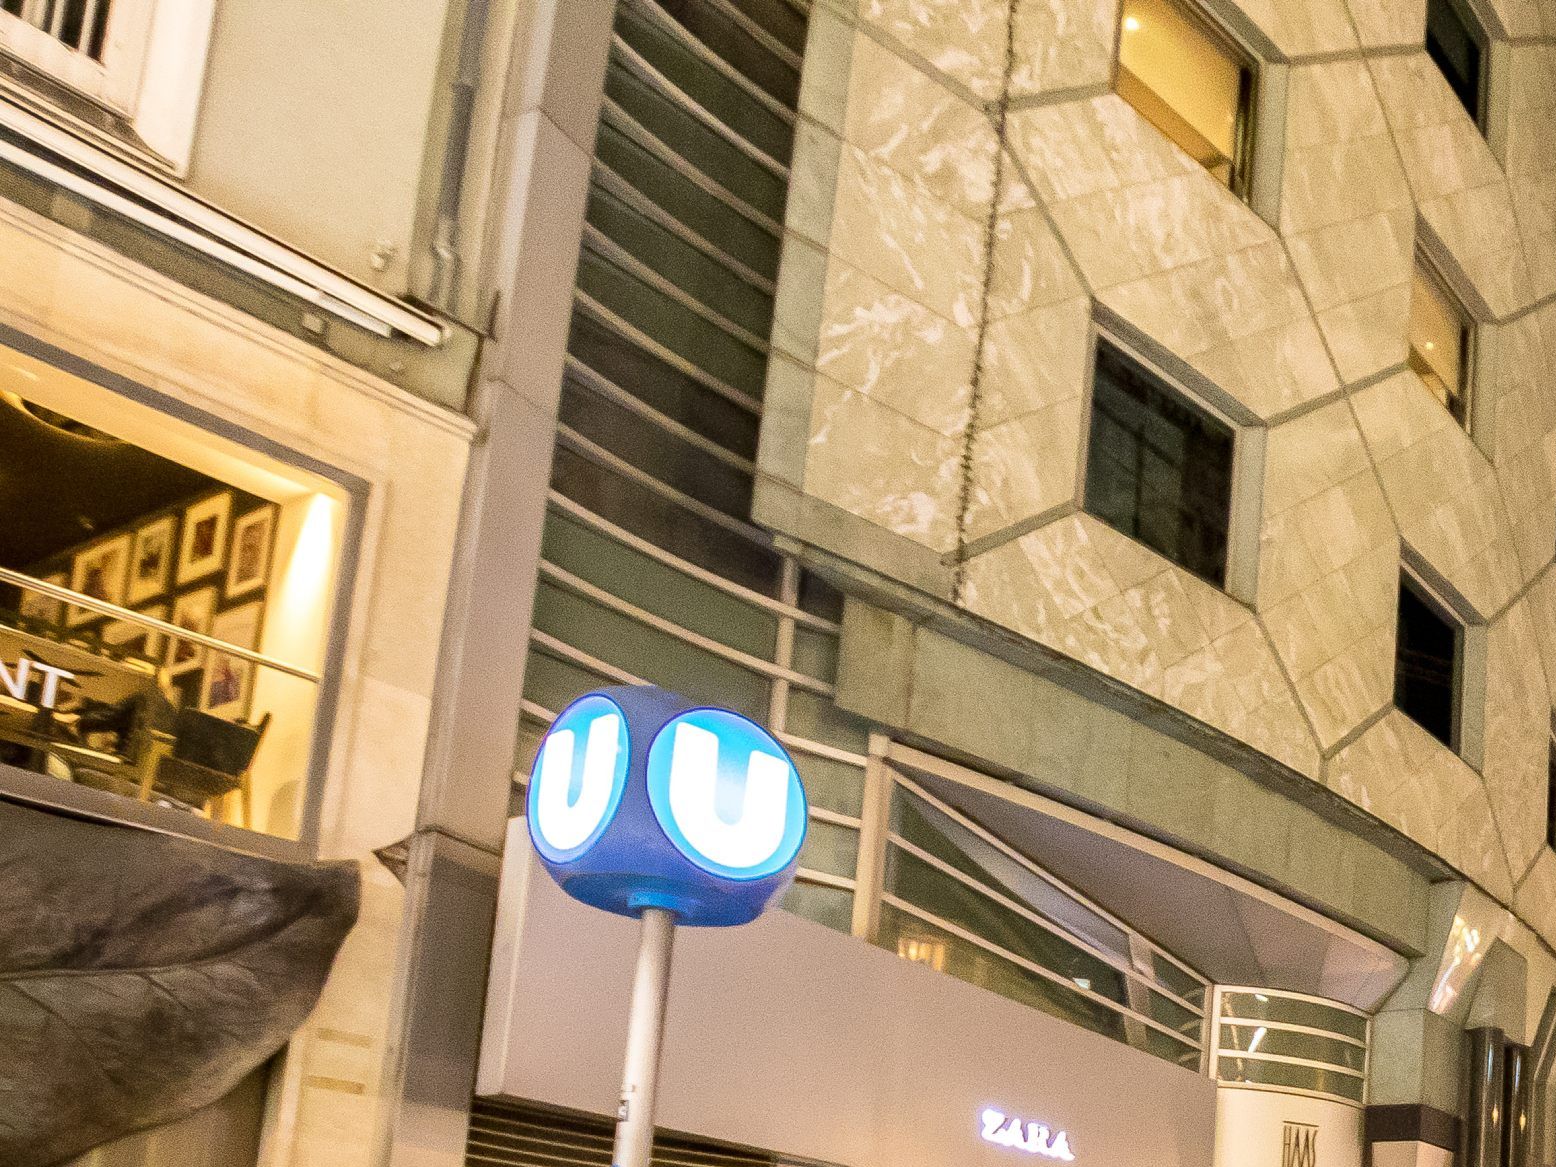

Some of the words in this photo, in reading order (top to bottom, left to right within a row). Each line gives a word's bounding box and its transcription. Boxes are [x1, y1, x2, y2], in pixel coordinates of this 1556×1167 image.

[537, 713, 619, 850] U
[669, 721, 790, 869] U
[981, 1108, 1076, 1161] ZARA
